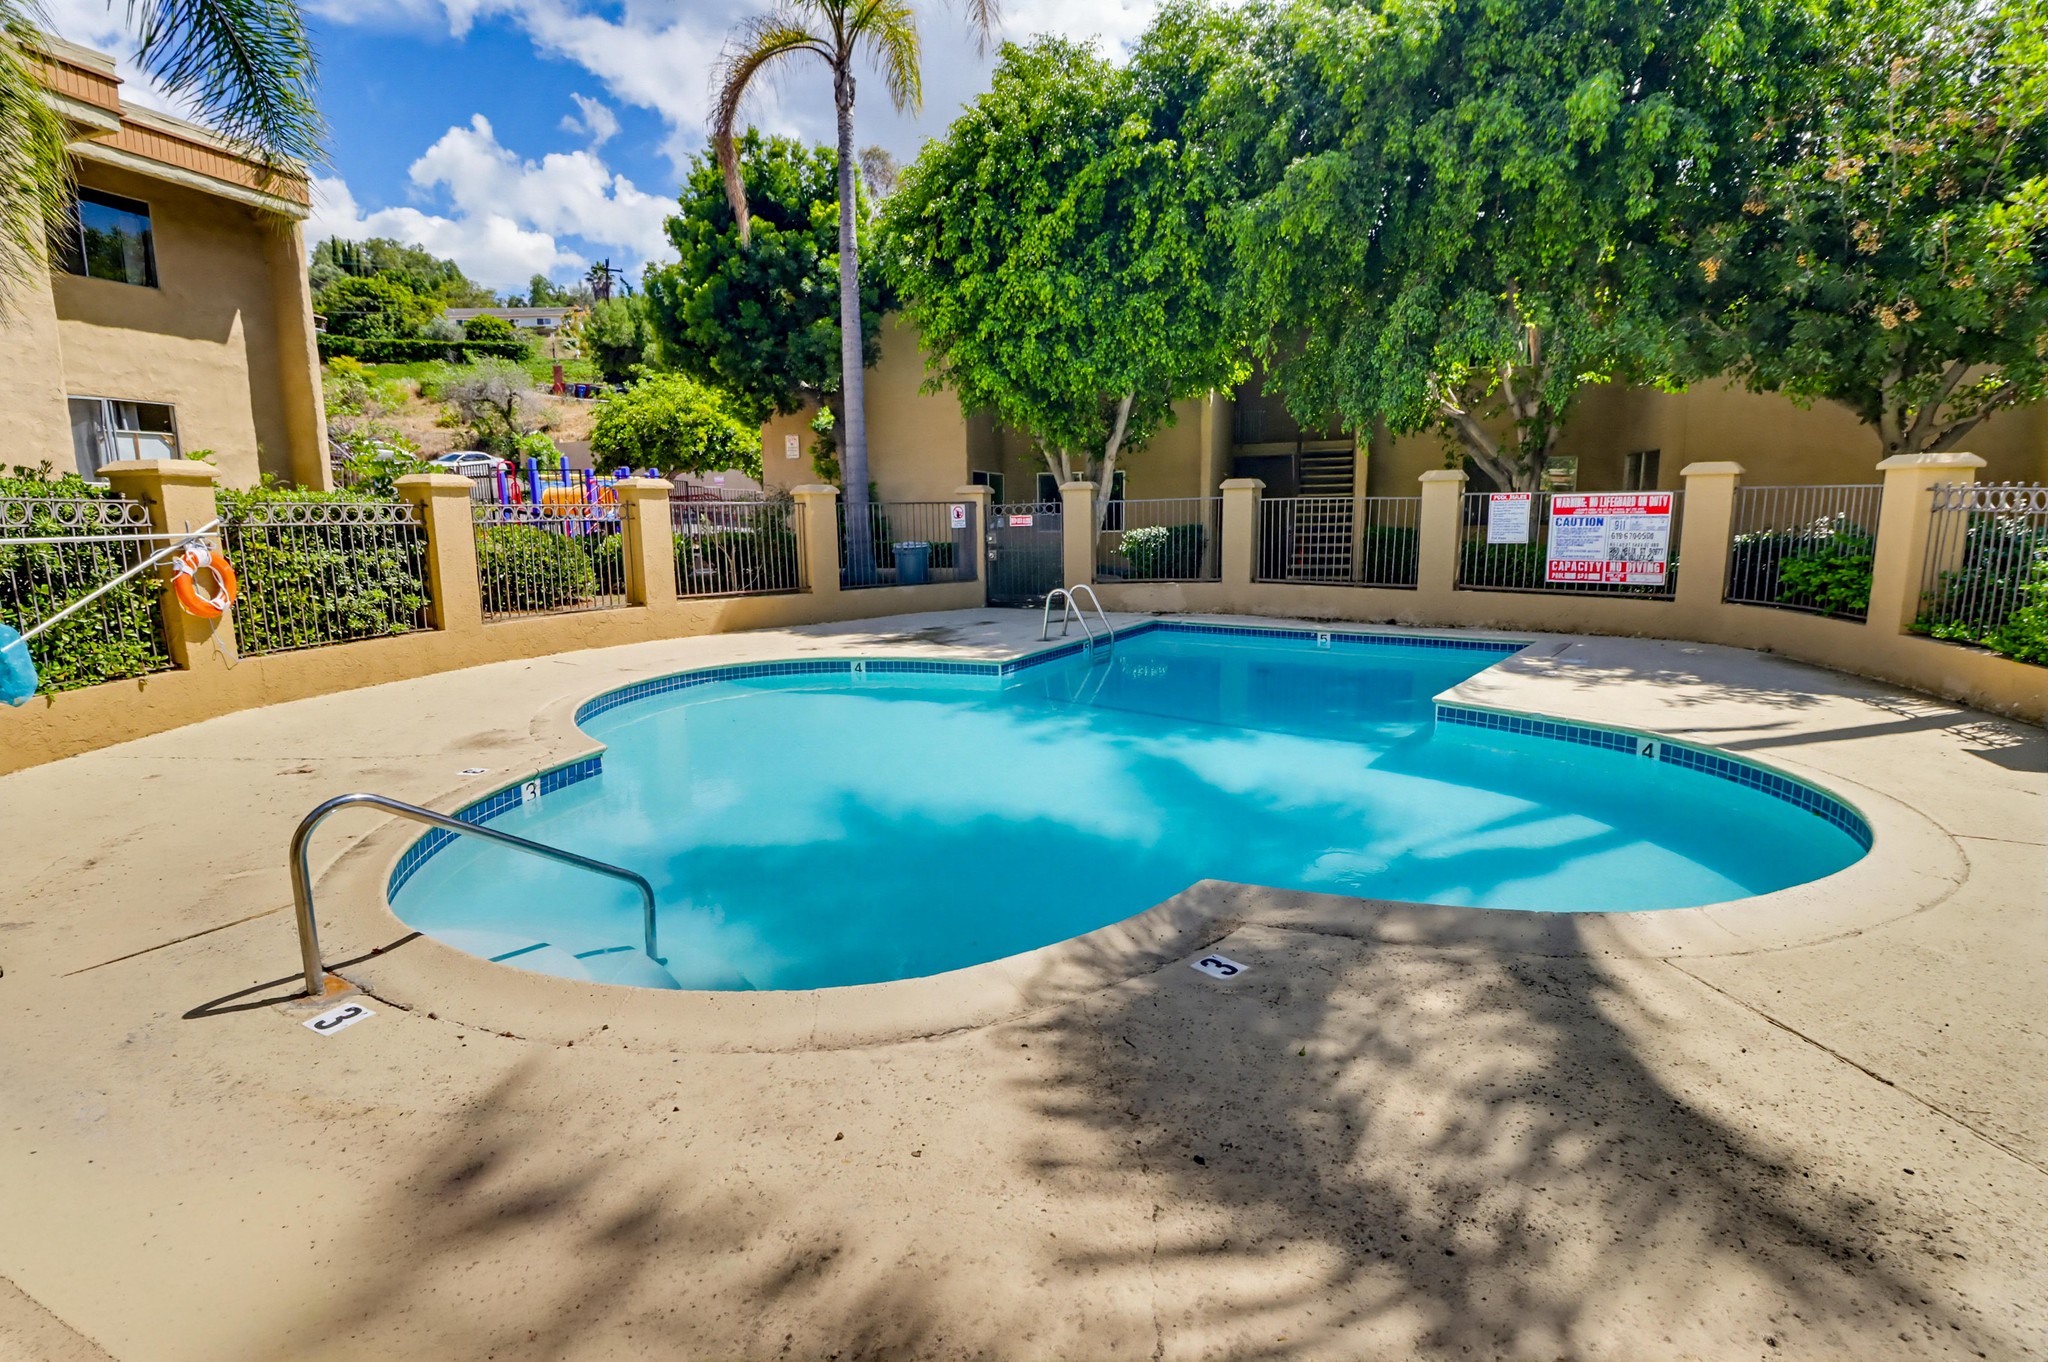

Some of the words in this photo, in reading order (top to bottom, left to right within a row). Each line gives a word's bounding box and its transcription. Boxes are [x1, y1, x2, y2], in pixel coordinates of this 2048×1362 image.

[1589, 497, 1599, 507] NO
[1600, 496, 1637, 508] LIFEGUARD
[1638, 496, 1648, 507] ON
[1649, 495, 1669, 507] DUTY
[1555, 517, 1604, 527] CAUTION
[1614, 520, 1626, 530] 911
[1552, 561, 1602, 572] CAPACITY
[1609, 562, 1622, 573] NO
[1627, 562, 1661, 574] DIVING
[1320, 634, 1328, 644] 5
[855, 662, 863, 673] 4
[1641, 742, 1655, 759] 4
[526, 782, 537, 802] 3
